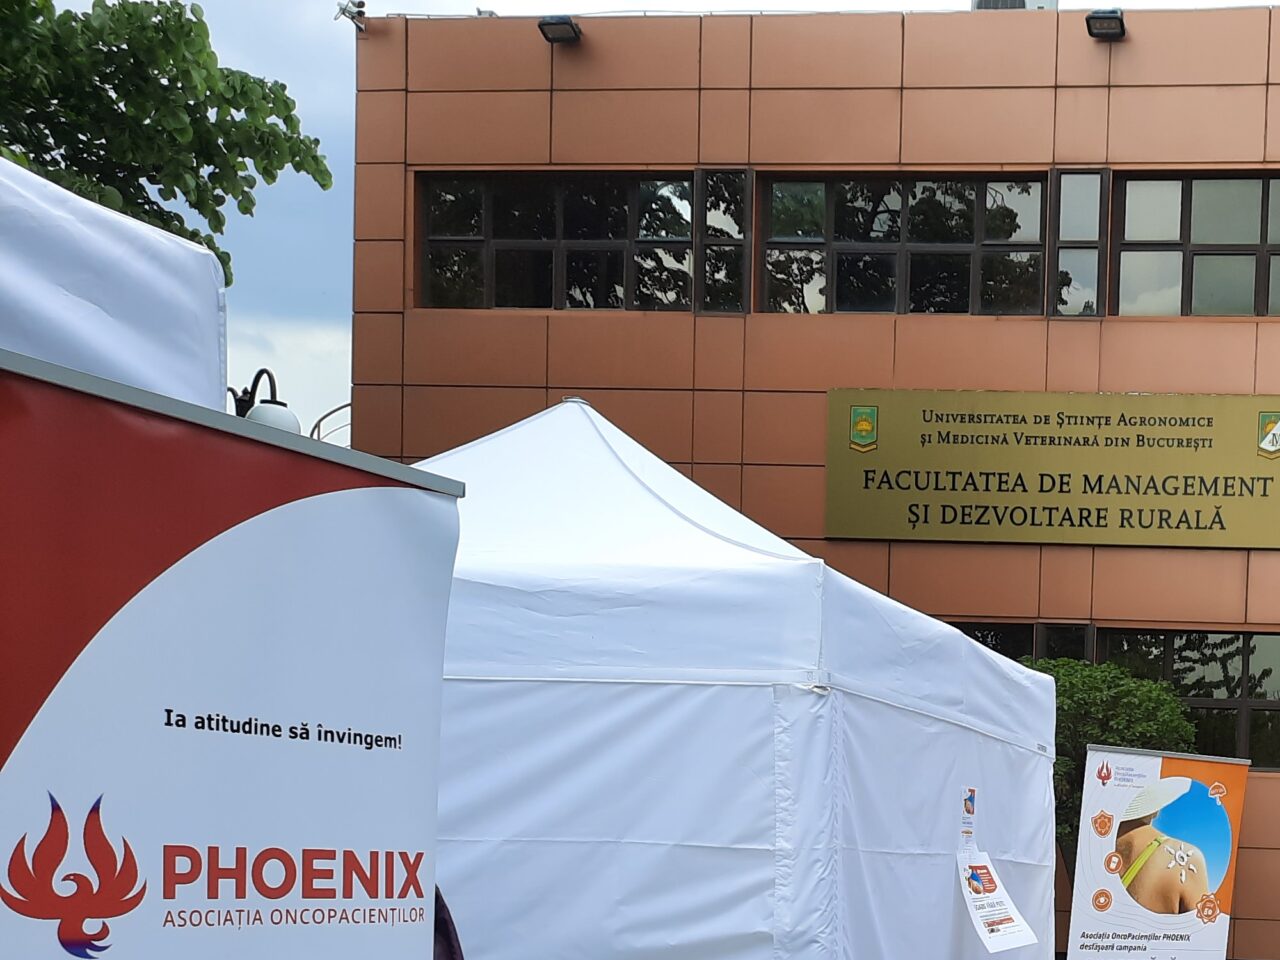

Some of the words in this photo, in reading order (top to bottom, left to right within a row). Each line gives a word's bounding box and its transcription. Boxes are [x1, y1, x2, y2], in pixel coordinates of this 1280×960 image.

[1034, 414, 1050, 426] DE
[863, 470, 1029, 494] FACULTATEA
[1039, 473, 1071, 494] DE
[1082, 474, 1274, 497] MANAGEMENT
[908, 504, 930, 527] ȘI
[940, 504, 1109, 529] DEZVOLTARE
[1118, 504, 1226, 530] RURALĂ
[164, 709, 187, 728] Ia
[194, 714, 282, 738] atitudine
[288, 722, 310, 740] să
[317, 724, 402, 750] învingem!
[162, 844, 424, 900] PHOENIX
[162, 908, 264, 931] ASOCIAȚIA
[270, 906, 425, 928] ONCOPACIENȚILOR
